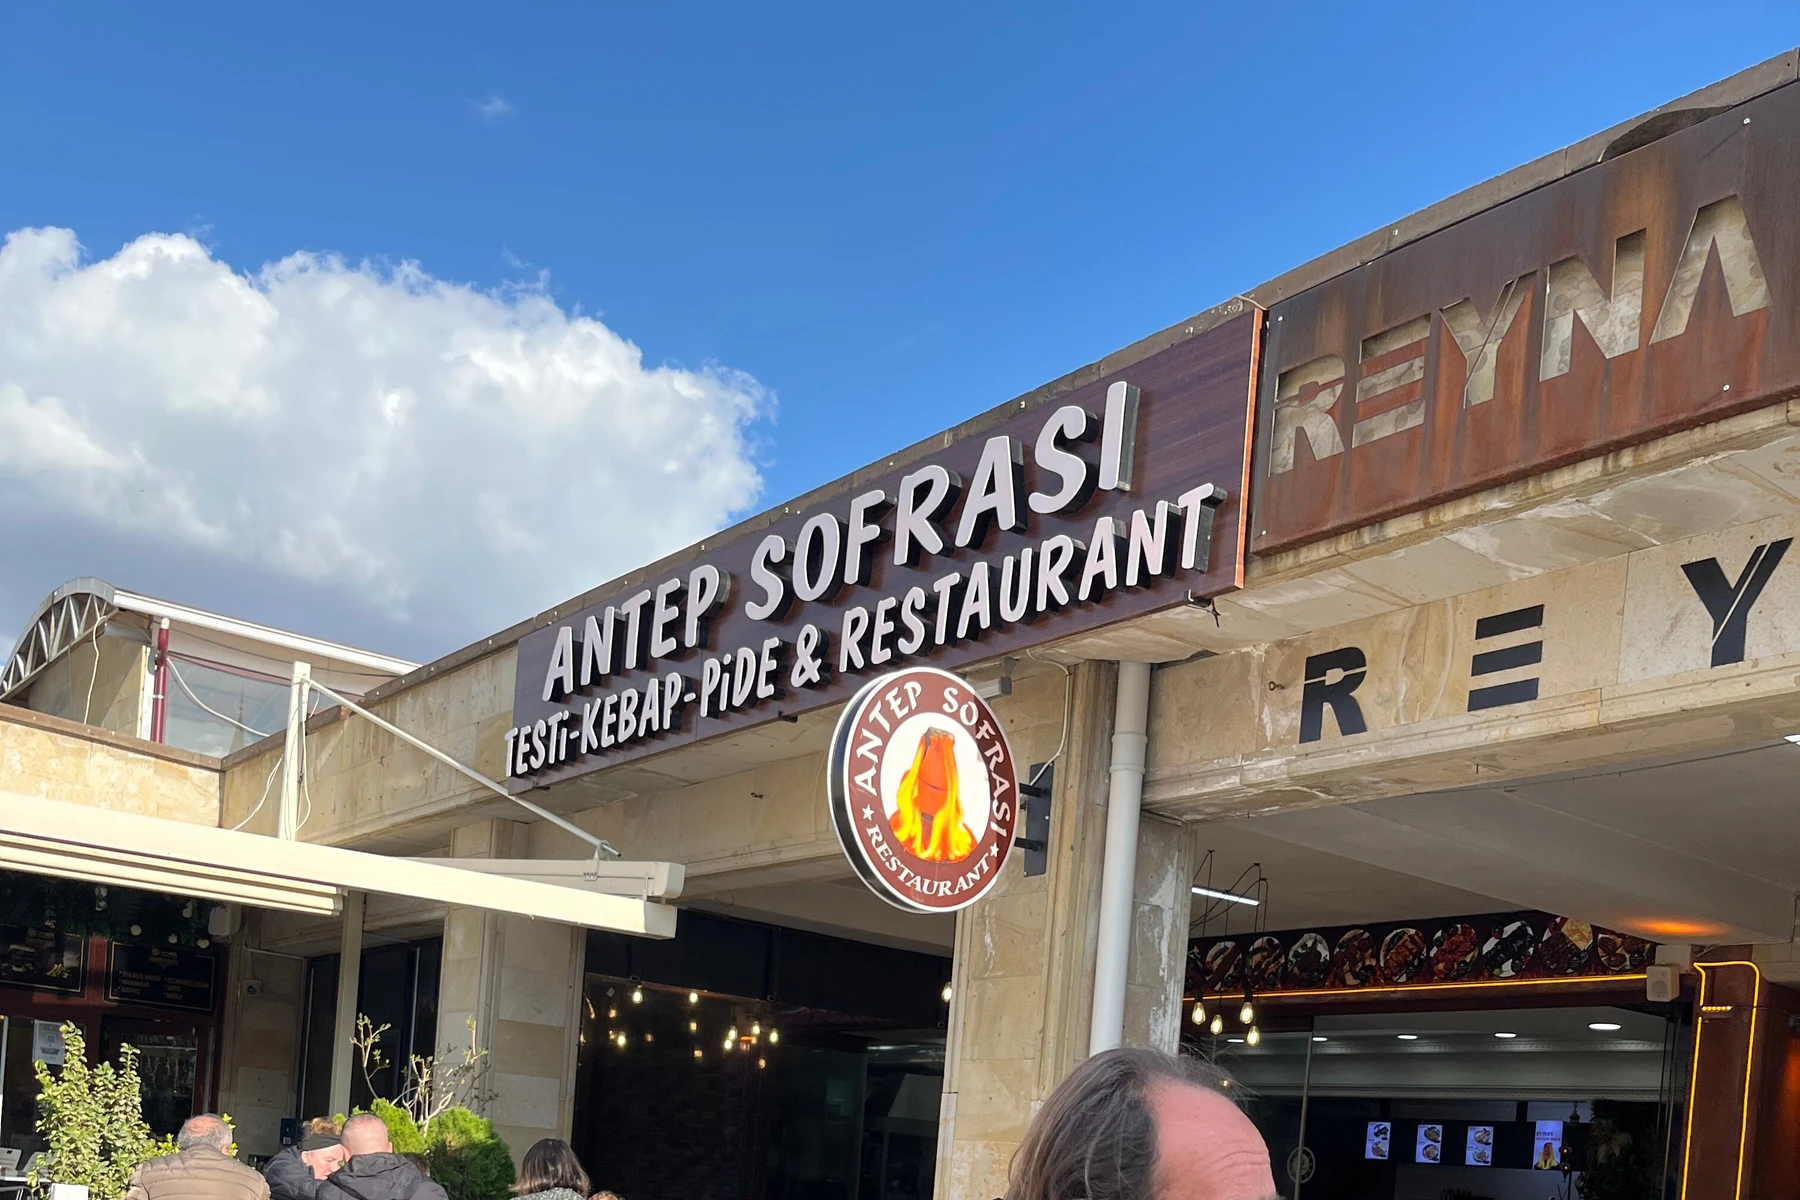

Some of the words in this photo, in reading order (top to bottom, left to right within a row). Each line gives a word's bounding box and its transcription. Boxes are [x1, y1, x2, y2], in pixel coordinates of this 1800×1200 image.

[1269, 194, 1772, 478] REYNA
[542, 564, 722, 703] ANTEP
[743, 380, 1129, 622] SOFRASI
[790, 623, 823, 689] &
[838, 482, 1216, 673] RESTAURANT
[853, 680, 922, 797] ANTEP
[942, 686, 1011, 838] SOFRASI
[865, 823, 993, 897] RESTAURANT
